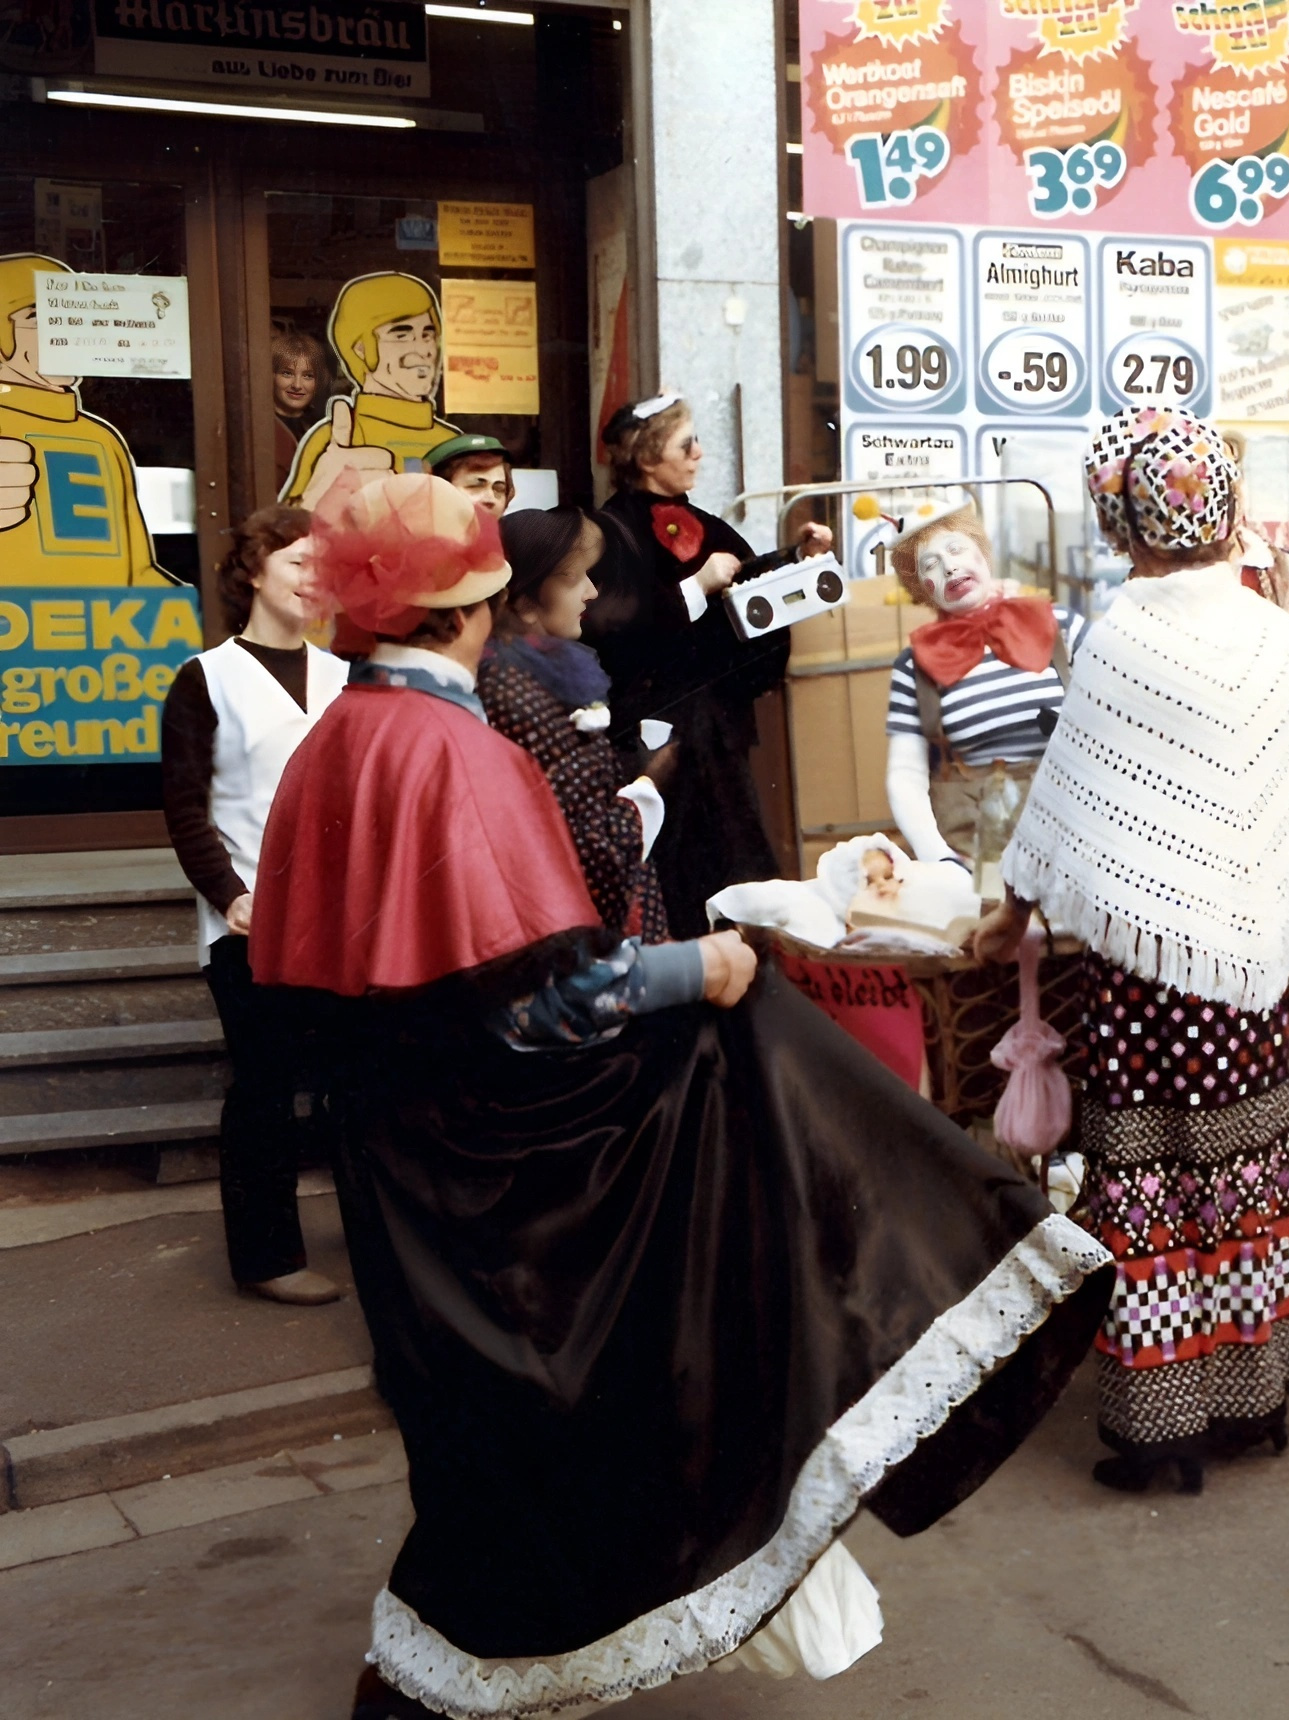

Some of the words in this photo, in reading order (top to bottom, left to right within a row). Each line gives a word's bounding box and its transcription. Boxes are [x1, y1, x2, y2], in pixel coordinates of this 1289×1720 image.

[1192, 79, 1288, 112] Nescafé
[1193, 109, 1250, 138] Gold
[850, 131, 946, 203] 1.49
[986, 262, 1079, 290] Almighurt
[1116, 250, 1195, 278] Kaba
[866, 344, 948, 391] 1.99
[998, 351, 1068, 392] -.59
[1123, 353, 1194, 395] 2.79
[2, 652, 182, 713] große
